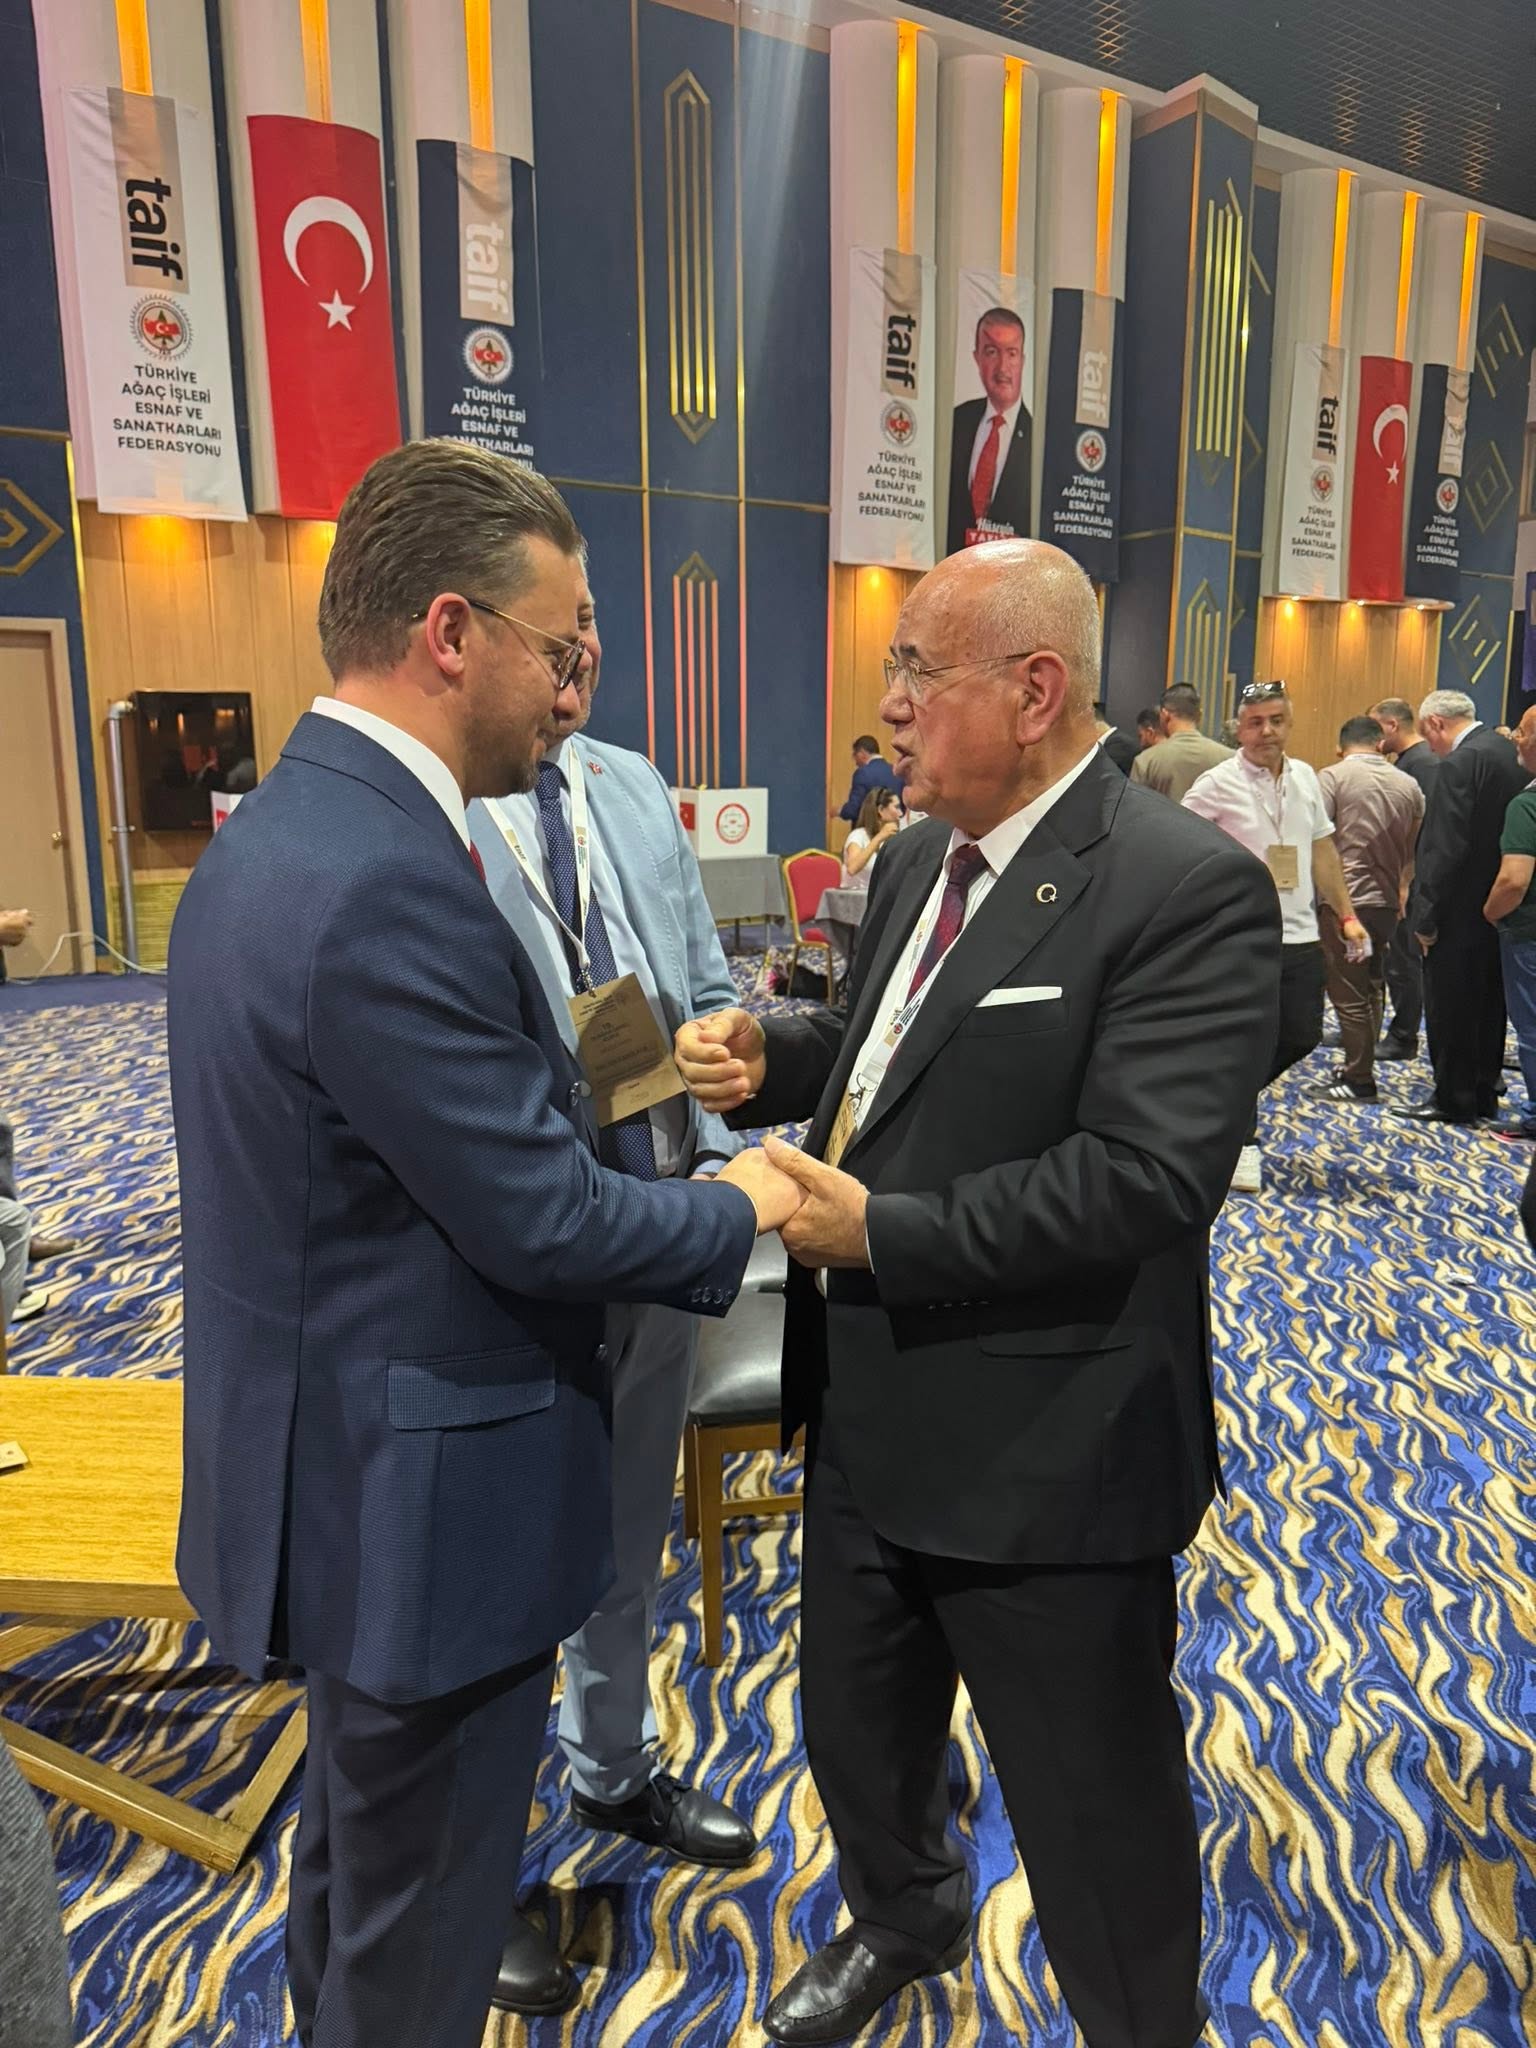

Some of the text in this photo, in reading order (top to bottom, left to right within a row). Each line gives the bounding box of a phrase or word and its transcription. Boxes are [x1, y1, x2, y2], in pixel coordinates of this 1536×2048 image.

[125, 177, 183, 280] taif
[466, 221, 509, 314] taif
[886, 314, 917, 390] taif
[134, 363, 198, 384] TÜRKİYE
[121, 380, 212, 404] AĞAÇ İŞLERİ
[463, 385, 516, 406] TÜRKİYE
[1082, 351, 1108, 419] taif
[135, 401, 203, 420] ESNAF VE
[450, 401, 526, 424] AĞAÇ İŞLERİ
[113, 418, 222, 440] SANATKARLARI
[461, 420, 519, 438] ESNAF VE
[1317, 396, 1339, 456] taif
[117, 436, 222, 457] FEDERASYONU
[878, 450, 916, 467] TÜRKİYE
[867, 463, 897, 479] AĞAÇ
[875, 479, 916, 494] ESNAF VE
[859, 505, 925, 522] FEDERASYONU
